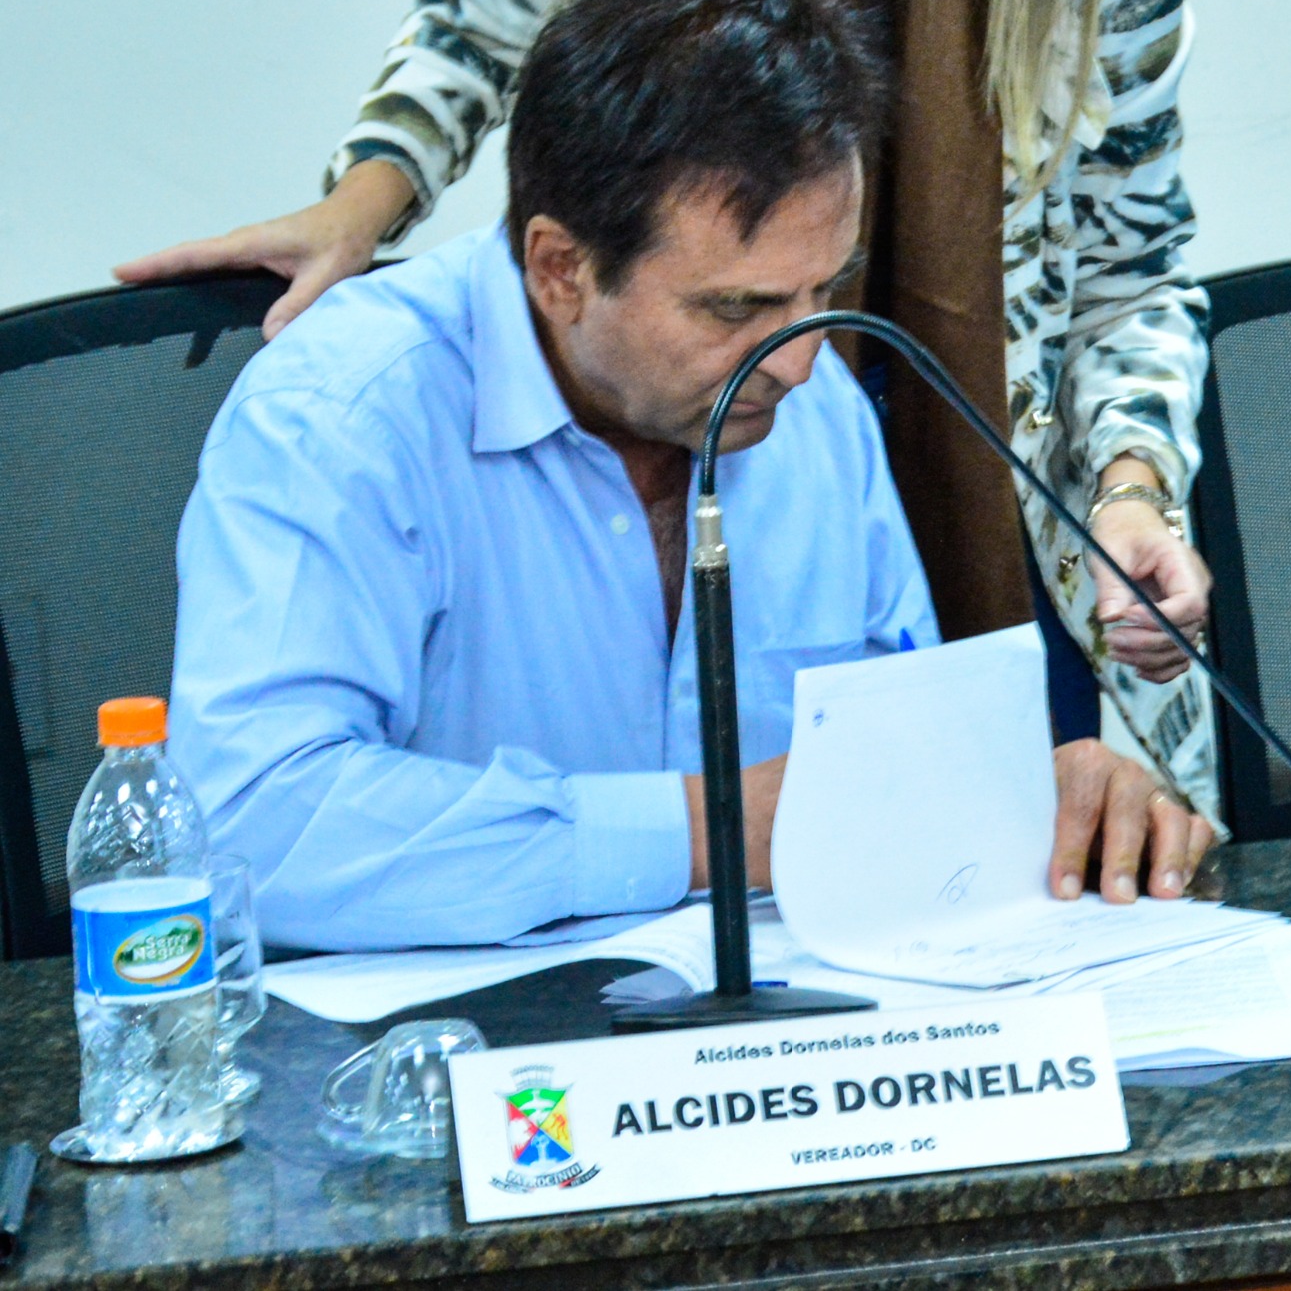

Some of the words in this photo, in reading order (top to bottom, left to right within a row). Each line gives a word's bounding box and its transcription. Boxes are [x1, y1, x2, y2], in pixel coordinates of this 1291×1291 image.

[133, 945, 185, 962] Negra
[145, 933, 189, 950] Serra
[694, 1044, 774, 1065] Alcides
[779, 1034, 876, 1056] Dornelas
[881, 1029, 921, 1046] dos
[925, 1020, 1002, 1042] Santos
[611, 1084, 821, 1139] ALCIDES
[835, 1054, 1098, 1113] DORNELAS
[791, 1140, 895, 1165] VEREADOR
[911, 1135, 937, 1153] DC
